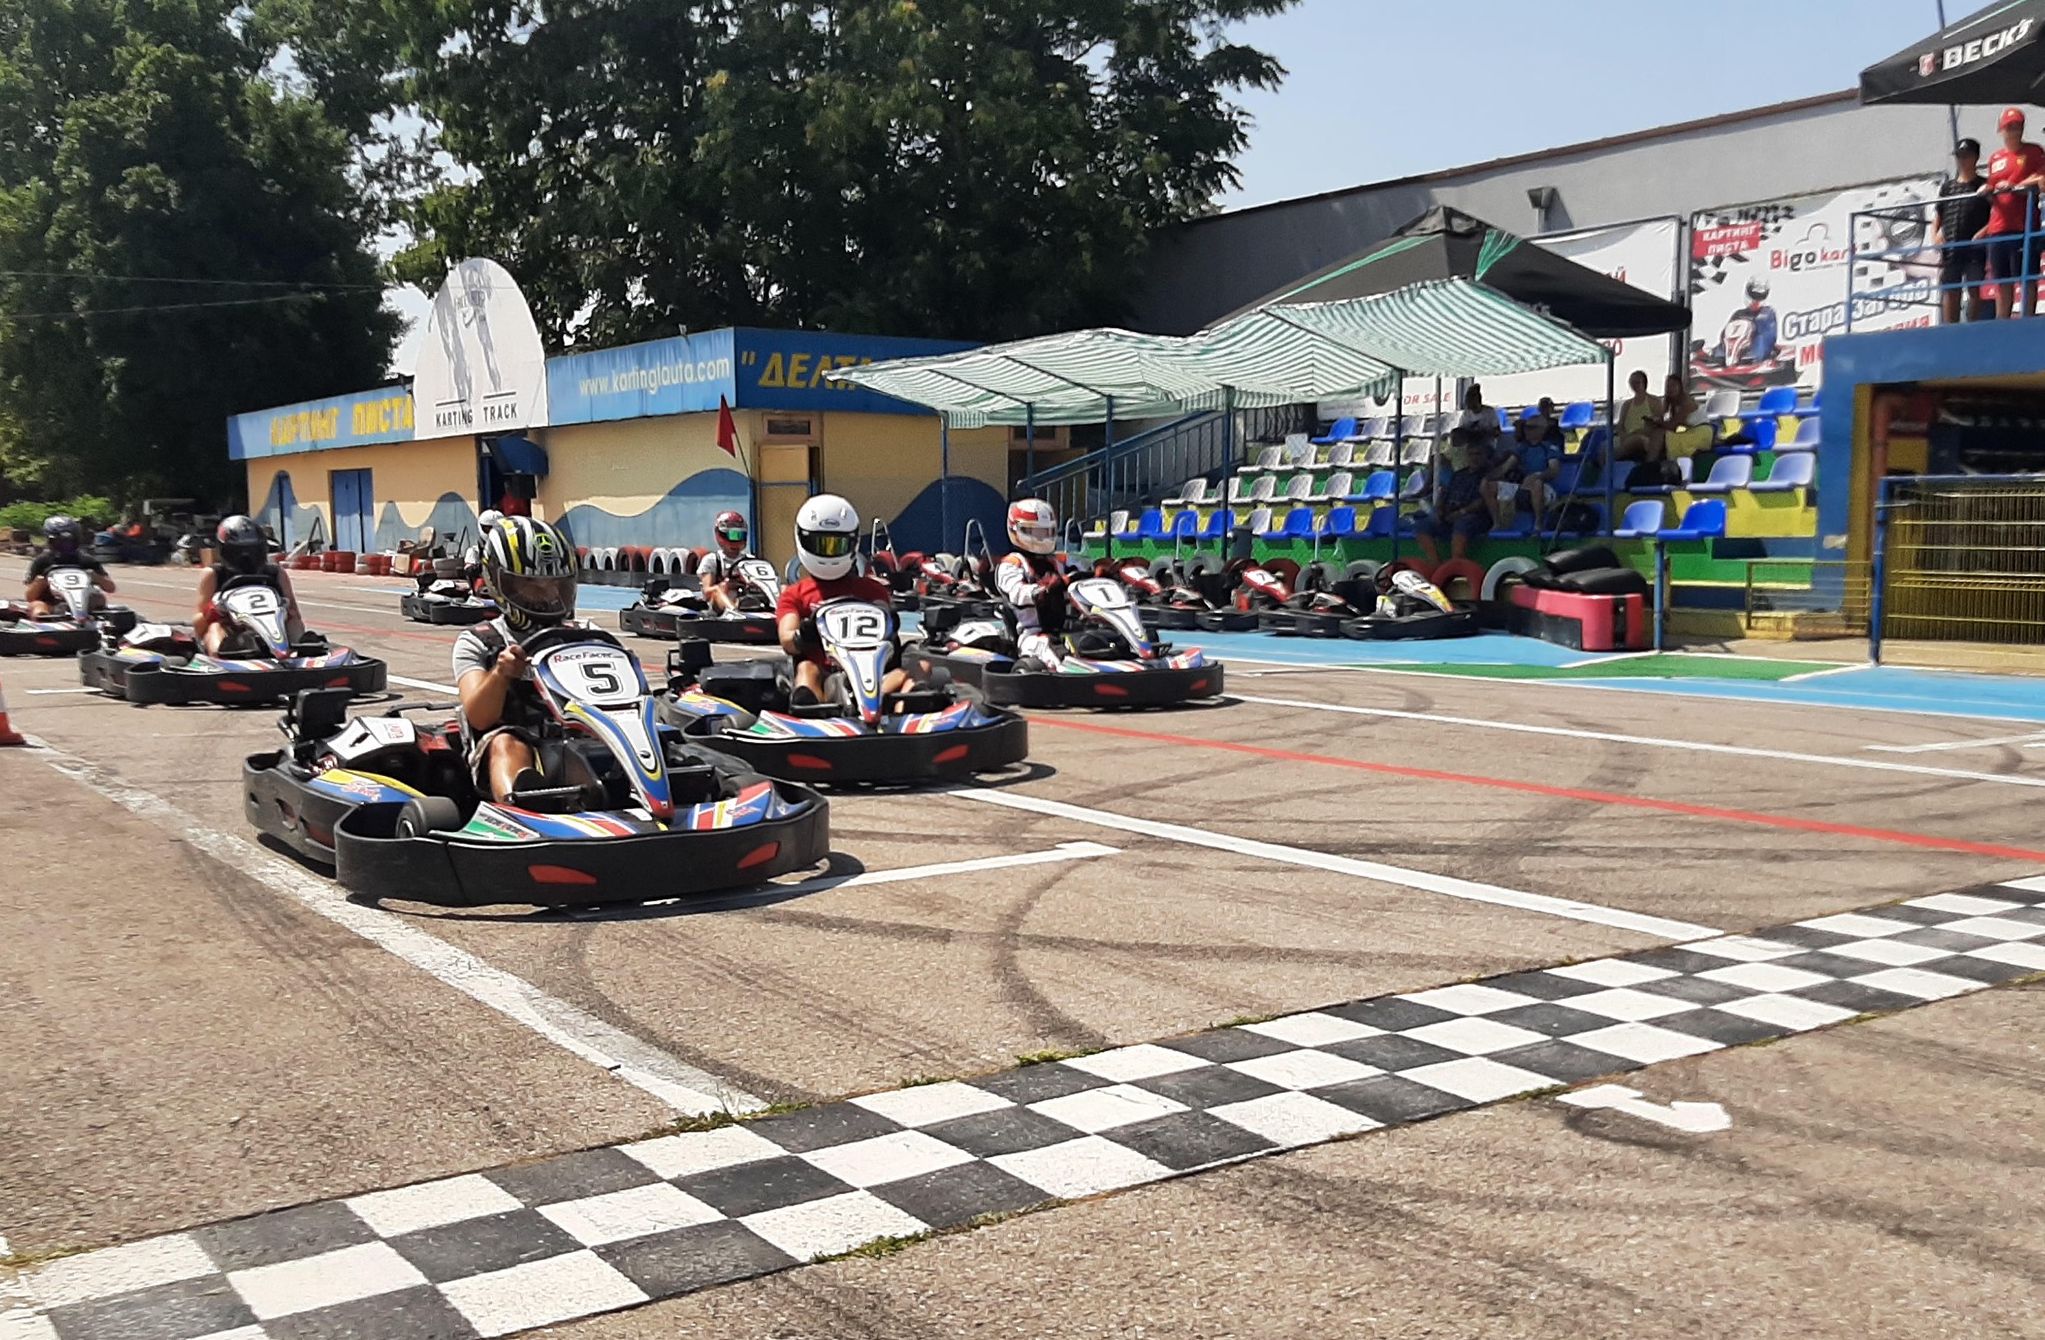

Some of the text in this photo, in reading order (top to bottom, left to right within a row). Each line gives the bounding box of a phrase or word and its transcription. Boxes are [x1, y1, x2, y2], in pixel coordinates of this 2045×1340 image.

[1941, 17, 2035, 71] BECK'S
[435, 402, 517, 428] KARTING TRACK
[65, 574, 79, 586] 9
[755, 566, 769, 576] 6
[248, 594, 269, 610] 2
[1097, 587, 1112, 602] 1
[840, 615, 879, 639] 12
[580, 662, 622, 696] 5
